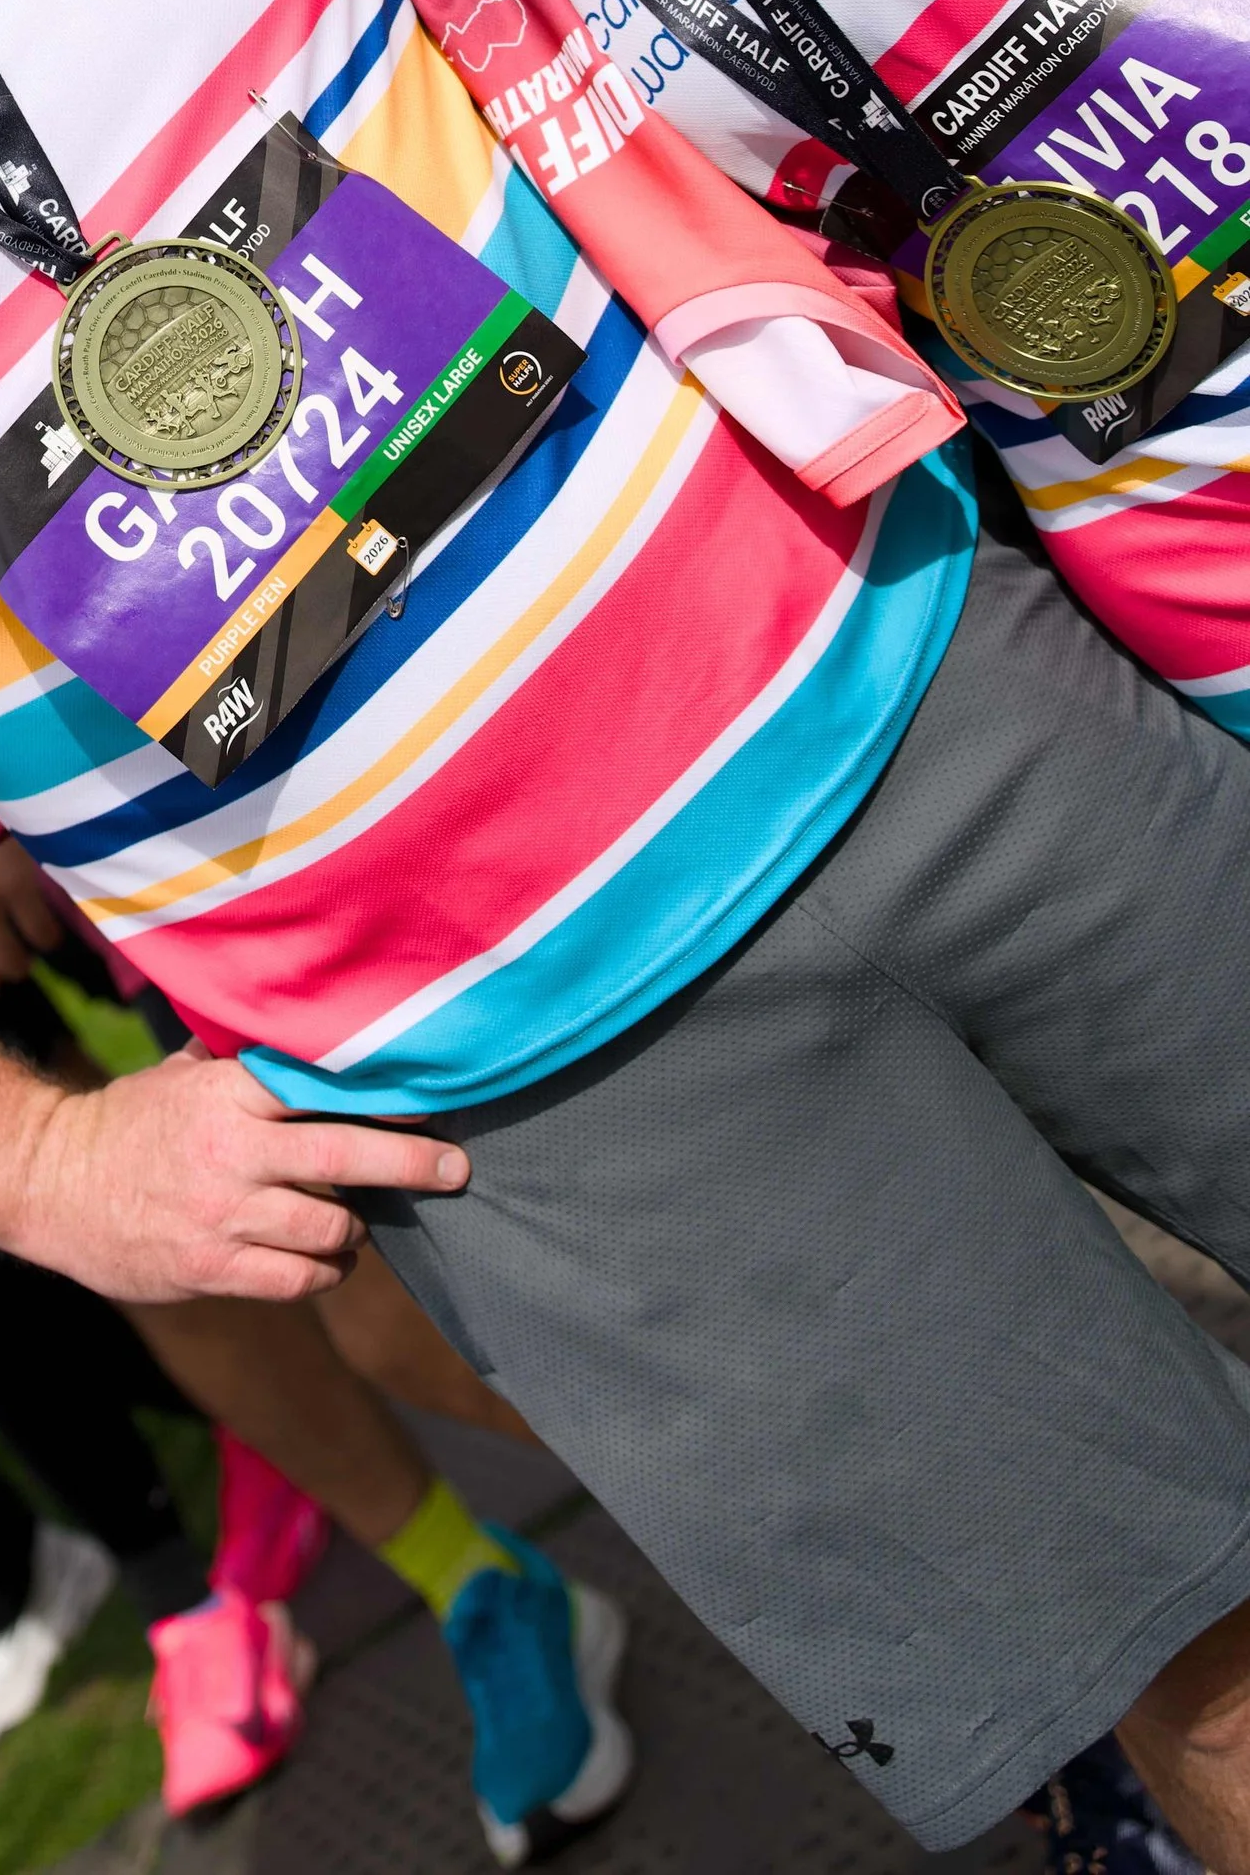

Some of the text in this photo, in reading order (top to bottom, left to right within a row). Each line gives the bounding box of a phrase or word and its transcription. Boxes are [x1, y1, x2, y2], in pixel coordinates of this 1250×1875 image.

[667, 2, 722, 54] MARATHON
[721, 48, 778, 93] CAERDYDD
[725, 24, 790, 76] HALF
[770, 8, 850, 100] CARDIFF
[827, 46, 864, 85] HANNER
[931, 35, 1030, 136] CARDIFF
[537, 61, 646, 197] DIFF
[956, 108, 1005, 154] HANNER
[1002, 54, 1062, 115] MARATHON
[1030, 57, 1202, 193] IVIA
[197, 197, 251, 251] ALF
[88, 313, 102, 332] Civic
[97, 292, 118, 315] Centre
[118, 276, 142, 294] Castell
[143, 268, 176, 281] Caerdydd
[182, 268, 213, 282] Stadiwm
[212, 276, 248, 305] Principality
[990, 240, 1080, 322] CARDIFF HALF
[1002, 251, 1090, 329] MARATHON 2026
[114, 303, 216, 393] CARDIFF HALF
[125, 318, 224, 402] MARATHON 2026
[133, 328, 229, 410] HANNER MARATHON CAERDYDD
[508, 359, 529, 382] SUPER
[512, 364, 535, 388] HALFS
[383, 347, 484, 462] UNISEX LARGE
[1082, 392, 1128, 432] R4W
[177, 346, 405, 603] 20724
[363, 534, 390, 565] 2026
[198, 575, 288, 677] PURPLE PEN
[203, 678, 255, 745] R4W
